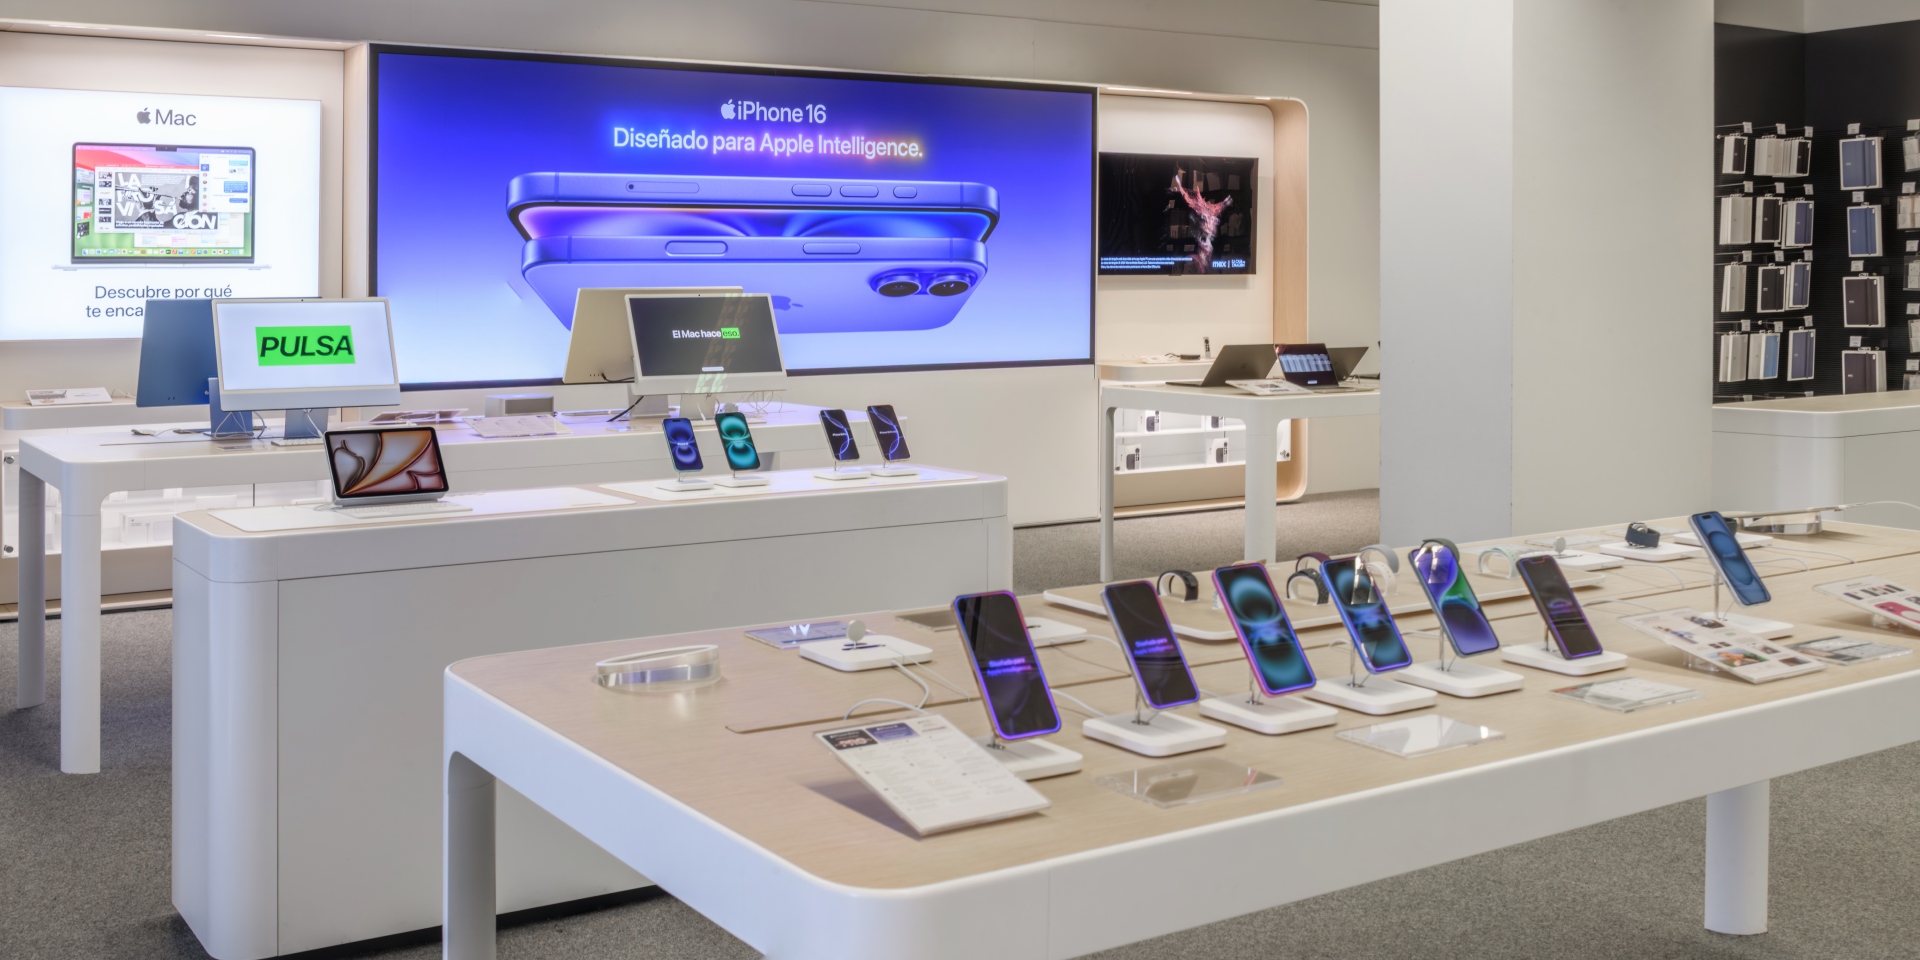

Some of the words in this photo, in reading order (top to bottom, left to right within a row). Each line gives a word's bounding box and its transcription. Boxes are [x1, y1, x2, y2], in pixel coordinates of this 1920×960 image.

[155, 108, 197, 126] Mac
[737, 101, 803, 122] iPhone
[805, 104, 827, 124] 16
[613, 127, 709, 150] Diseñado
[712, 135, 755, 154] para
[760, 132, 814, 156] Apple
[818, 134, 923, 159] Intelligence.
[94, 285, 171, 299] Descubre
[174, 287, 200, 300] por
[203, 284, 232, 299] qué
[86, 305, 101, 318] te
[672, 330, 681, 338] El
[681, 329, 700, 338] Mac
[700, 329, 722, 338] hace
[260, 335, 354, 358] PULSA
